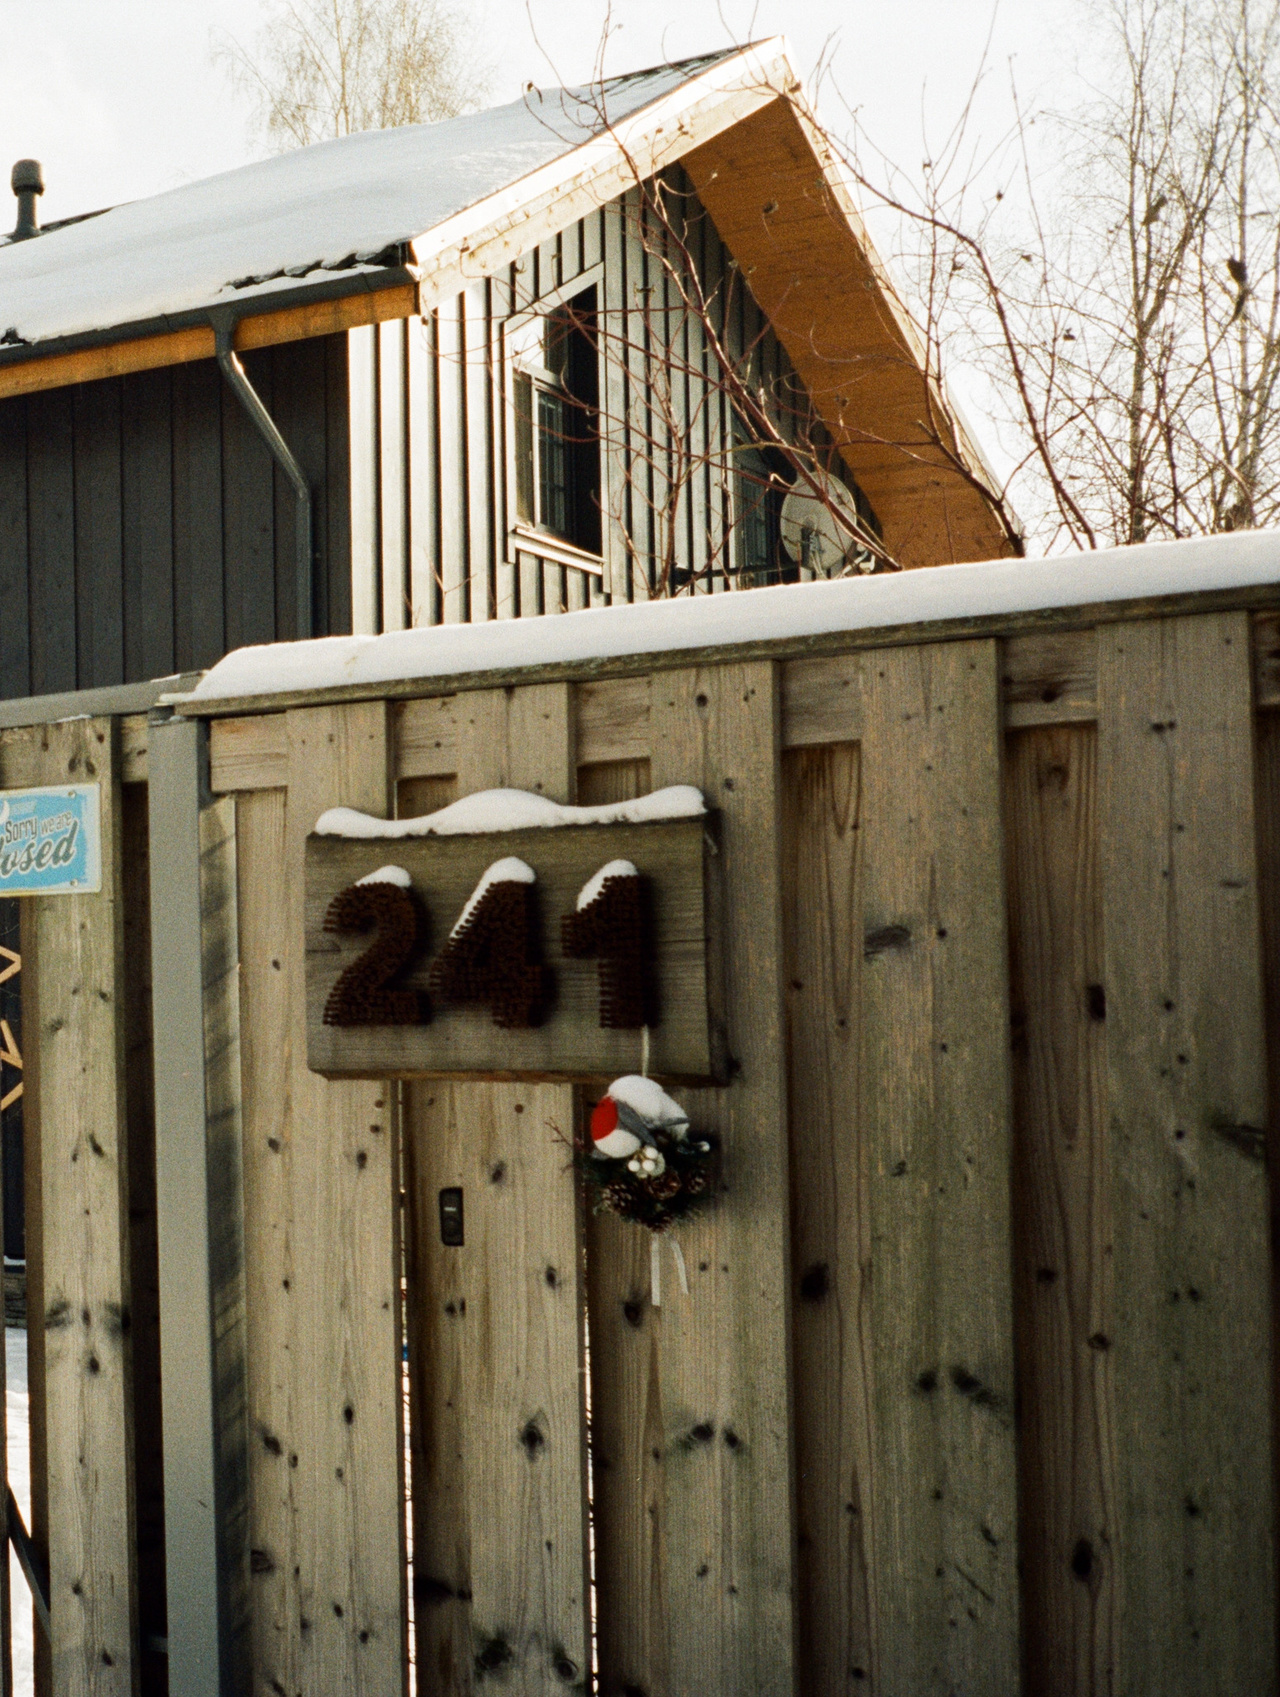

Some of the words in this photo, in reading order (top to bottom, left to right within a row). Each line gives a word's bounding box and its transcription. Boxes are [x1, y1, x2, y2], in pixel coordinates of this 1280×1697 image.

[4, 816, 38, 844] Sorry
[40, 818, 55, 836] we
[55, 811, 73, 831] are
[322, 868, 660, 1029] 241
